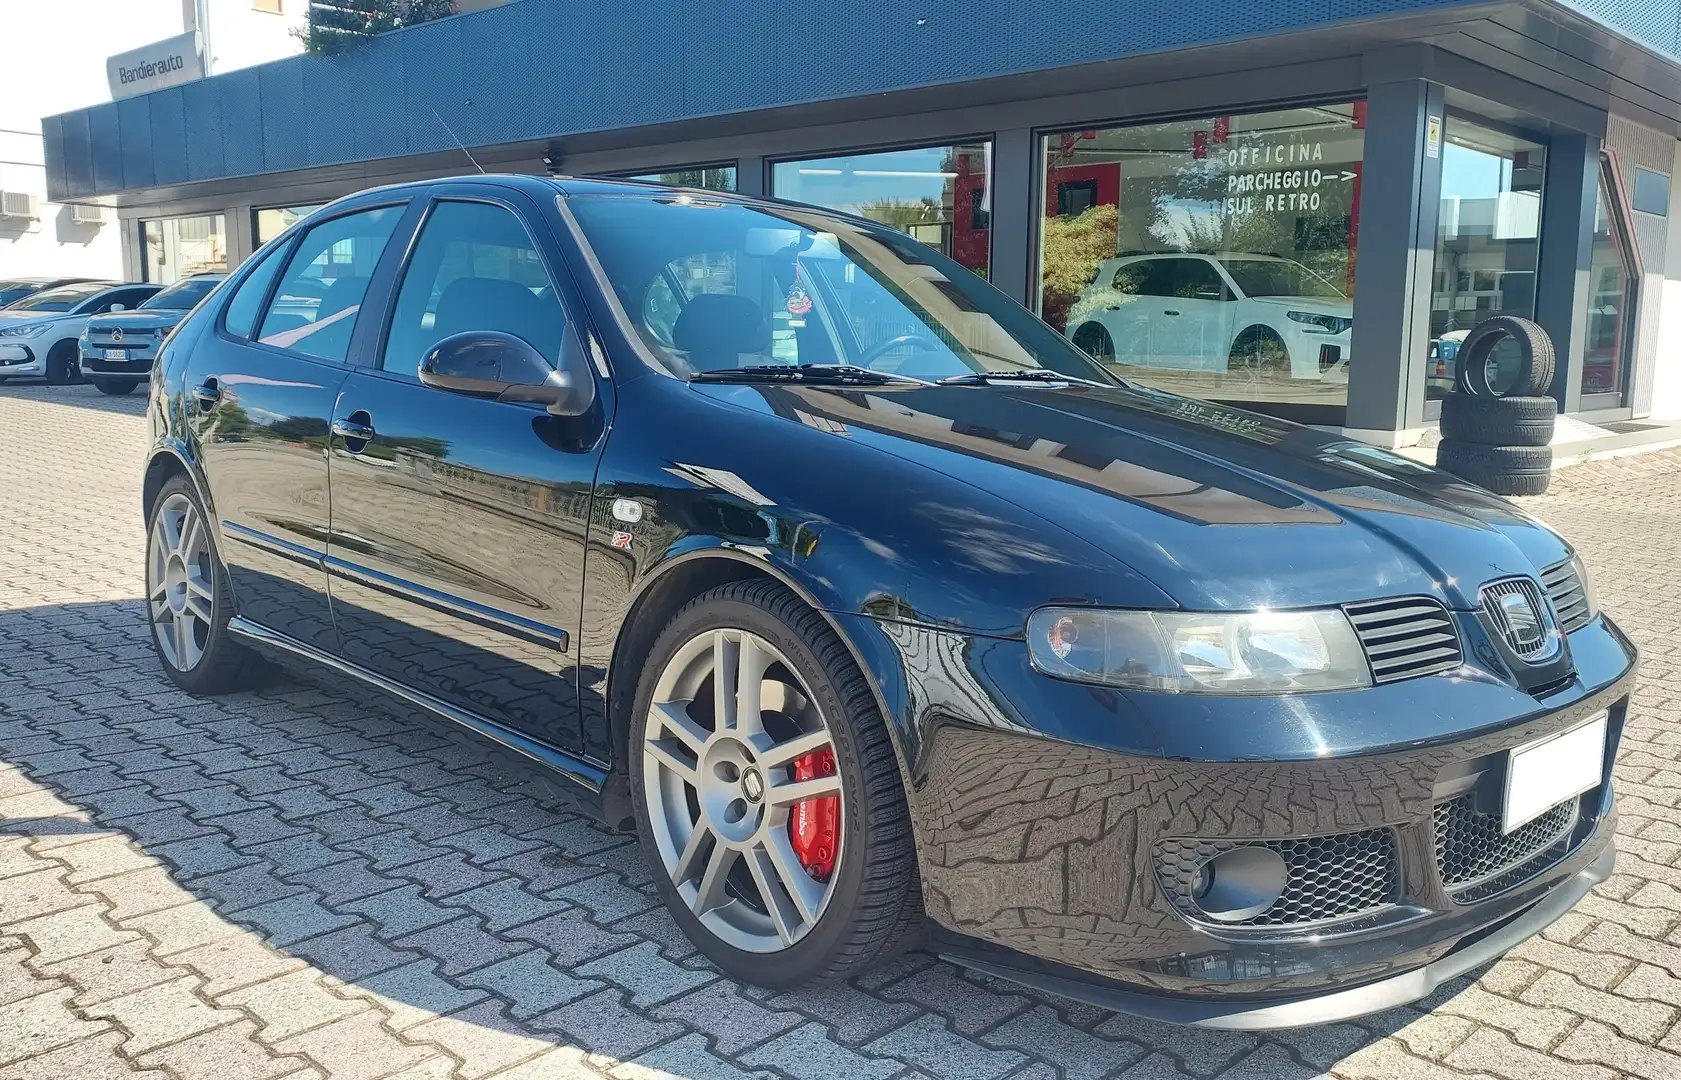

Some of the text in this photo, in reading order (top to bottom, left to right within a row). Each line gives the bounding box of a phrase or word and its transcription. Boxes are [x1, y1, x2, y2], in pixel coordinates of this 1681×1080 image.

[119, 54, 184, 84] Bandierauto
[1228, 143, 1322, 167] OFFICINA
[1228, 169, 1321, 192] PARCHEGGIO
[1227, 192, 1320, 215] SUL RETRO
